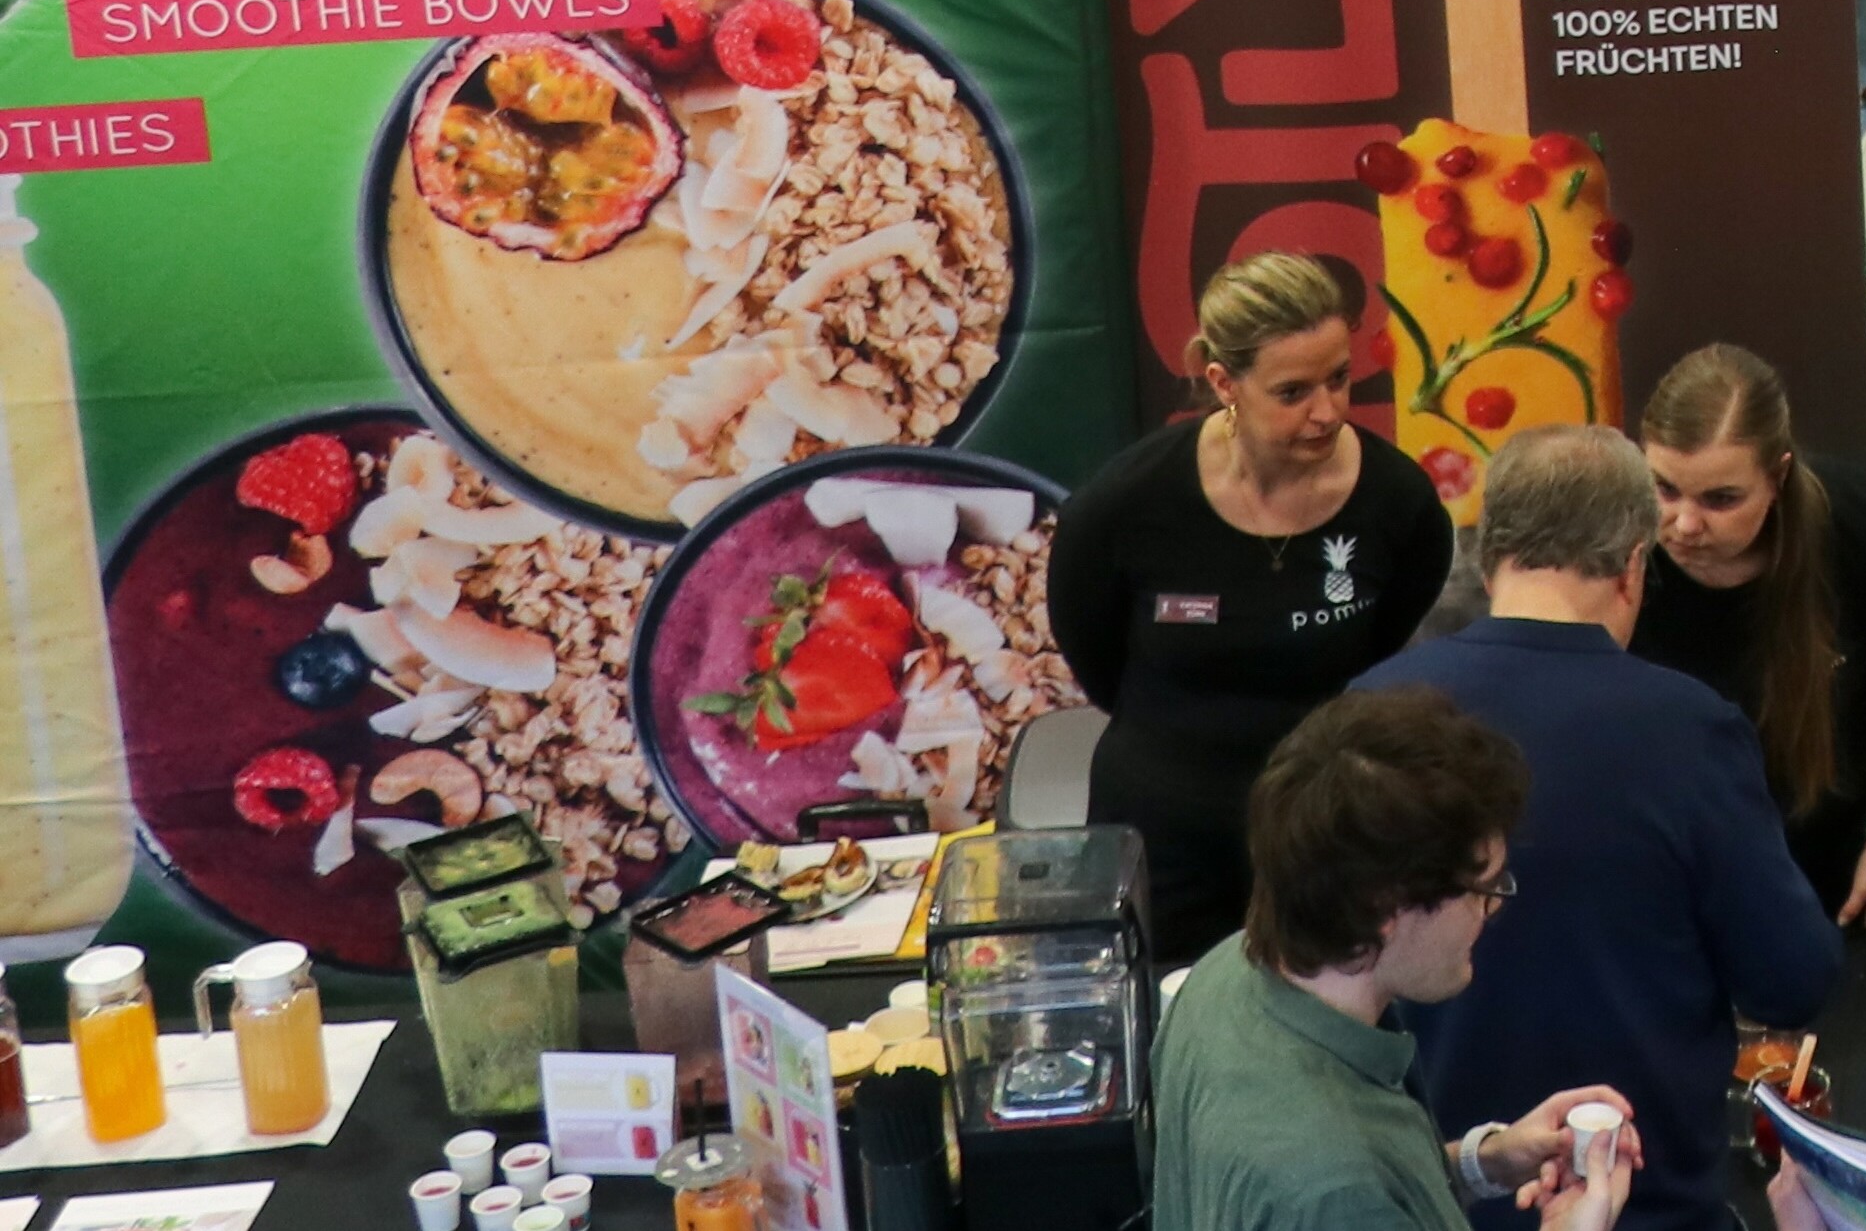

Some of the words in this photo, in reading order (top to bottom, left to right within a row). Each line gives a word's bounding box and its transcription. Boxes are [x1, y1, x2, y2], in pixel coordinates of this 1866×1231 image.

[1552, 9, 1641, 38] 100%
[1648, 3, 1778, 35] ECHTEN
[1556, 41, 1742, 77] FRÜCHTEN!
[0, 113, 177, 162] THIES
